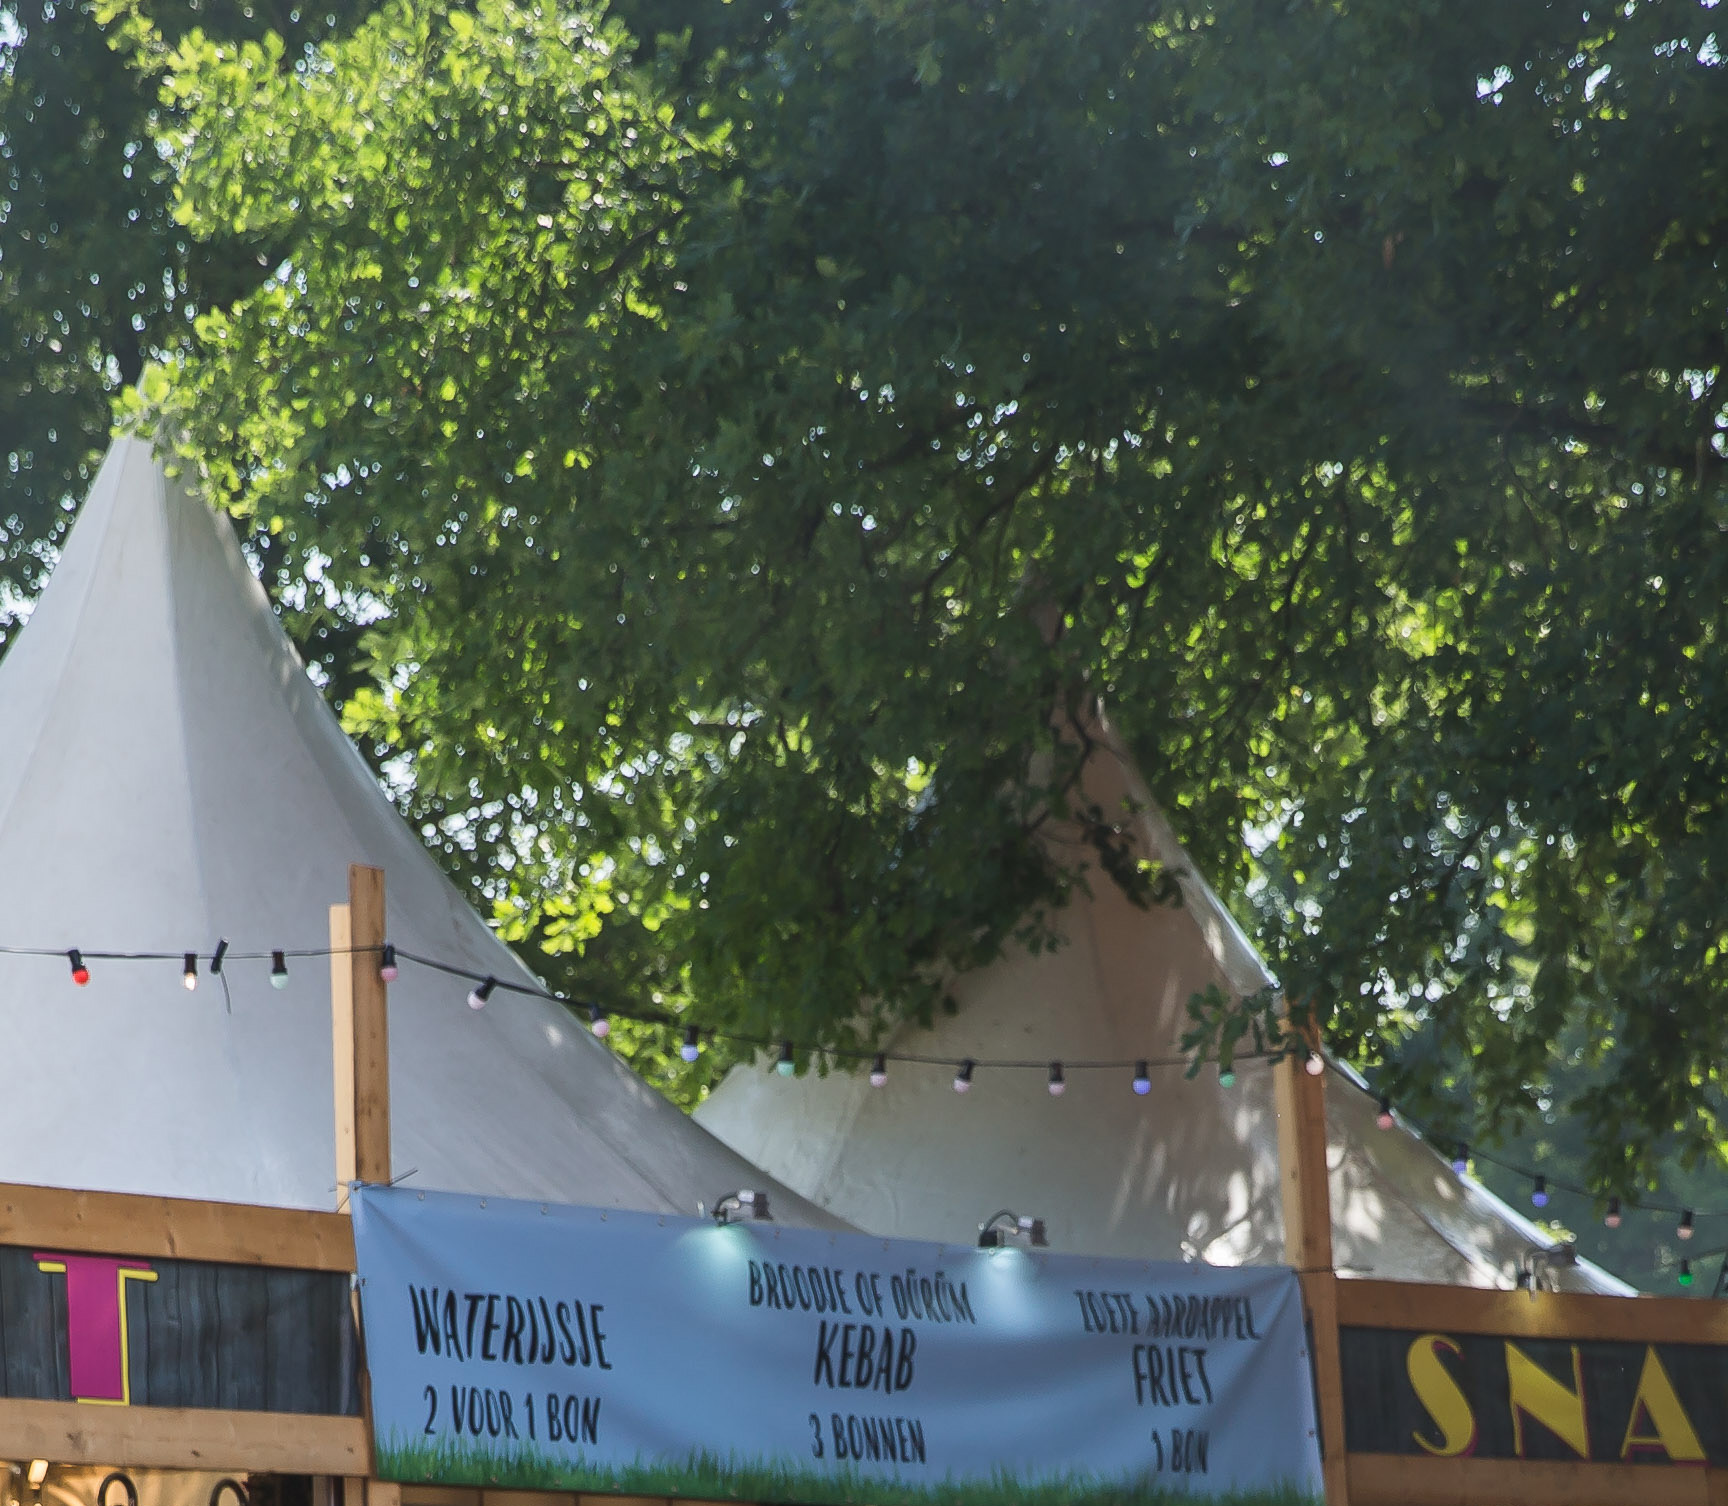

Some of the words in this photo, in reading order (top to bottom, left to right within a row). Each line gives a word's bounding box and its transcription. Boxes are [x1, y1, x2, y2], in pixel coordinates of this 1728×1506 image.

[748, 1259, 852, 1316] BROODJE
[854, 1270, 885, 1319] OF
[1073, 1289, 1140, 1336] ZOETE
[1144, 1293, 1262, 1342] AARDAPPEL
[408, 1283, 613, 1371] WATERIJSJE
[813, 1319, 918, 1395] KEBAB
[1132, 1343, 1214, 1408] FRIET
[424, 1384, 438, 1436] 2
[450, 1384, 520, 1441] VOOR
[525, 1392, 536, 1441] 1
[546, 1392, 602, 1446] BON
[808, 1412, 825, 1460] 3
[830, 1412, 928, 1465] BONNEN
[1150, 1427, 1165, 1474] 1
[1170, 1428, 1211, 1475] BON
